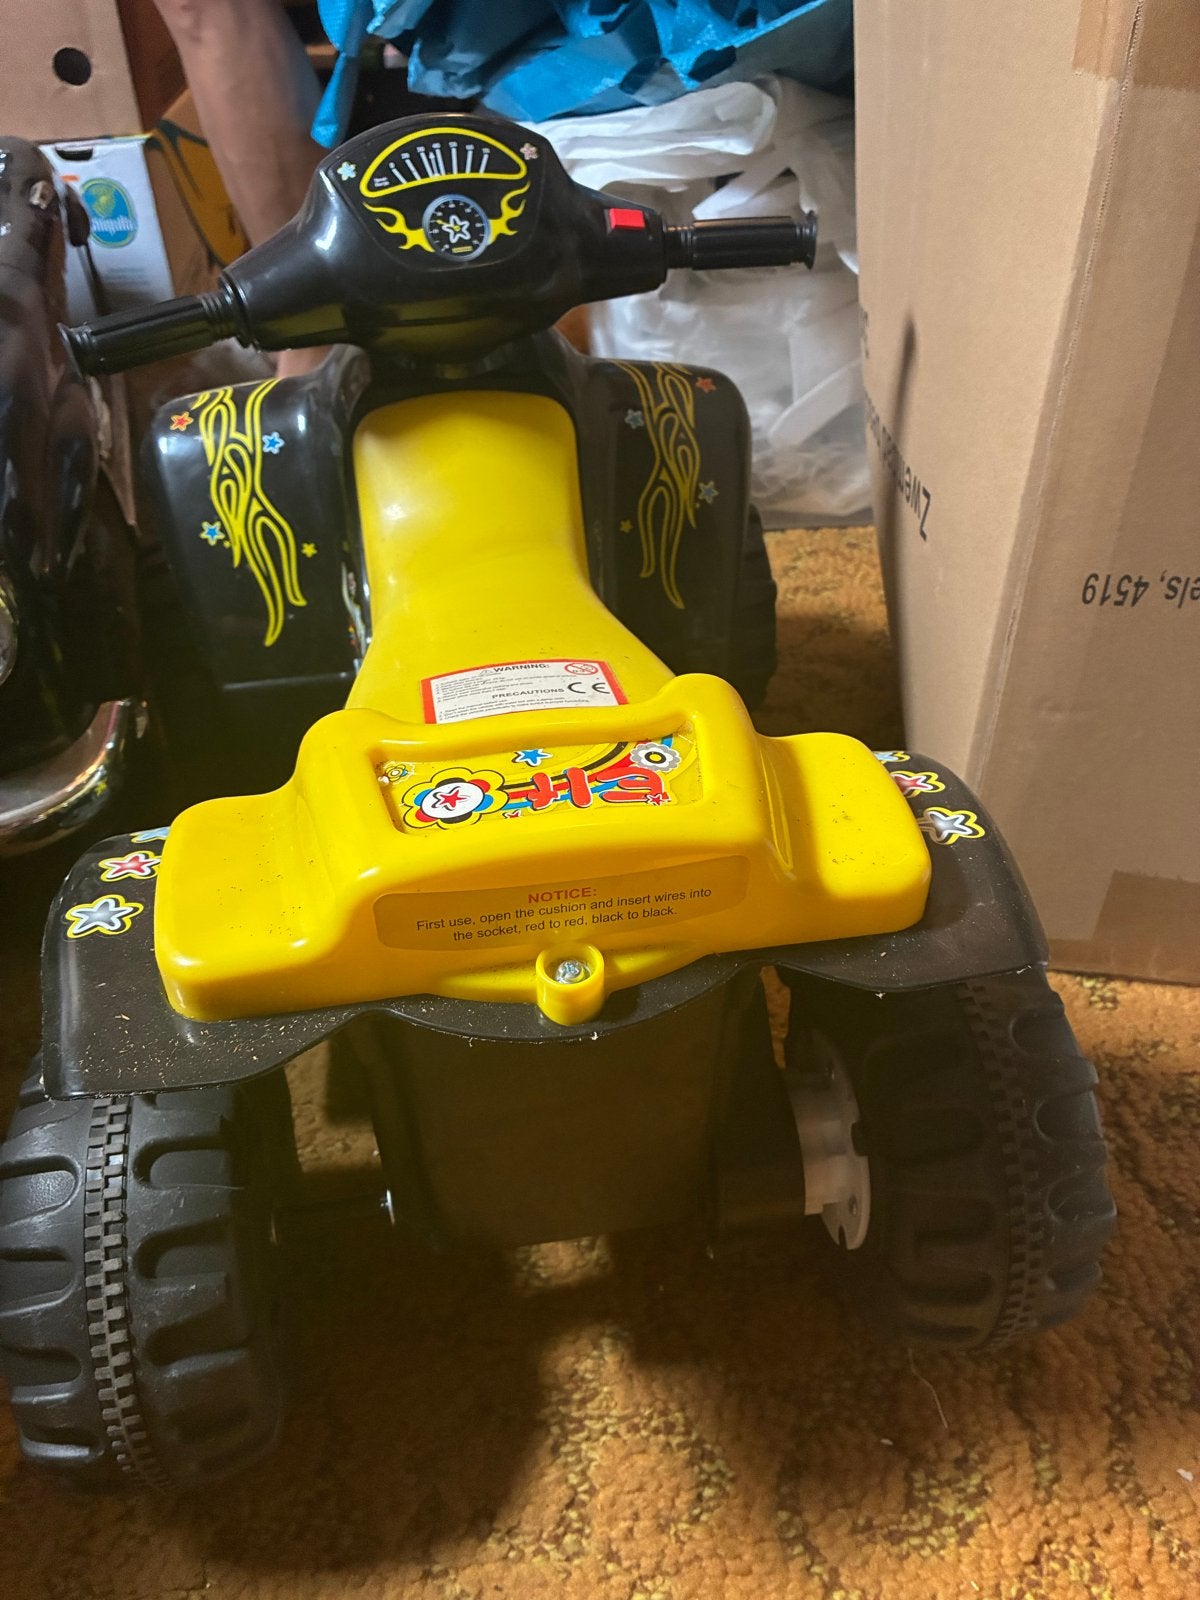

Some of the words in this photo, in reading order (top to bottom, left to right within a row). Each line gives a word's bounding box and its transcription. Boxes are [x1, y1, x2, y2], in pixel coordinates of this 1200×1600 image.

[1082, 573, 1149, 607] 4519
[493, 664, 550, 673] WARNING:
[492, 688, 565, 699] PRECAUTIONS
[528, 887, 597, 903] NOTICE:
[416, 918, 445, 931] First
[449, 917, 476, 927] use,
[480, 912, 511, 924] open
[515, 908, 535, 919] the
[538, 902, 586, 915] cushion
[590, 898, 613, 910] and
[617, 894, 651, 907] insert
[654, 892, 686, 903] wires
[689, 888, 712, 899] into
[453, 931, 473, 941] the
[477, 925, 521, 938] socket,
[525, 921, 545, 932] red
[549, 919, 561, 929] to
[564, 916, 588, 927] red,
[592, 911, 624, 924] black
[627, 910, 639, 919] to
[642, 906, 678, 918] black.
